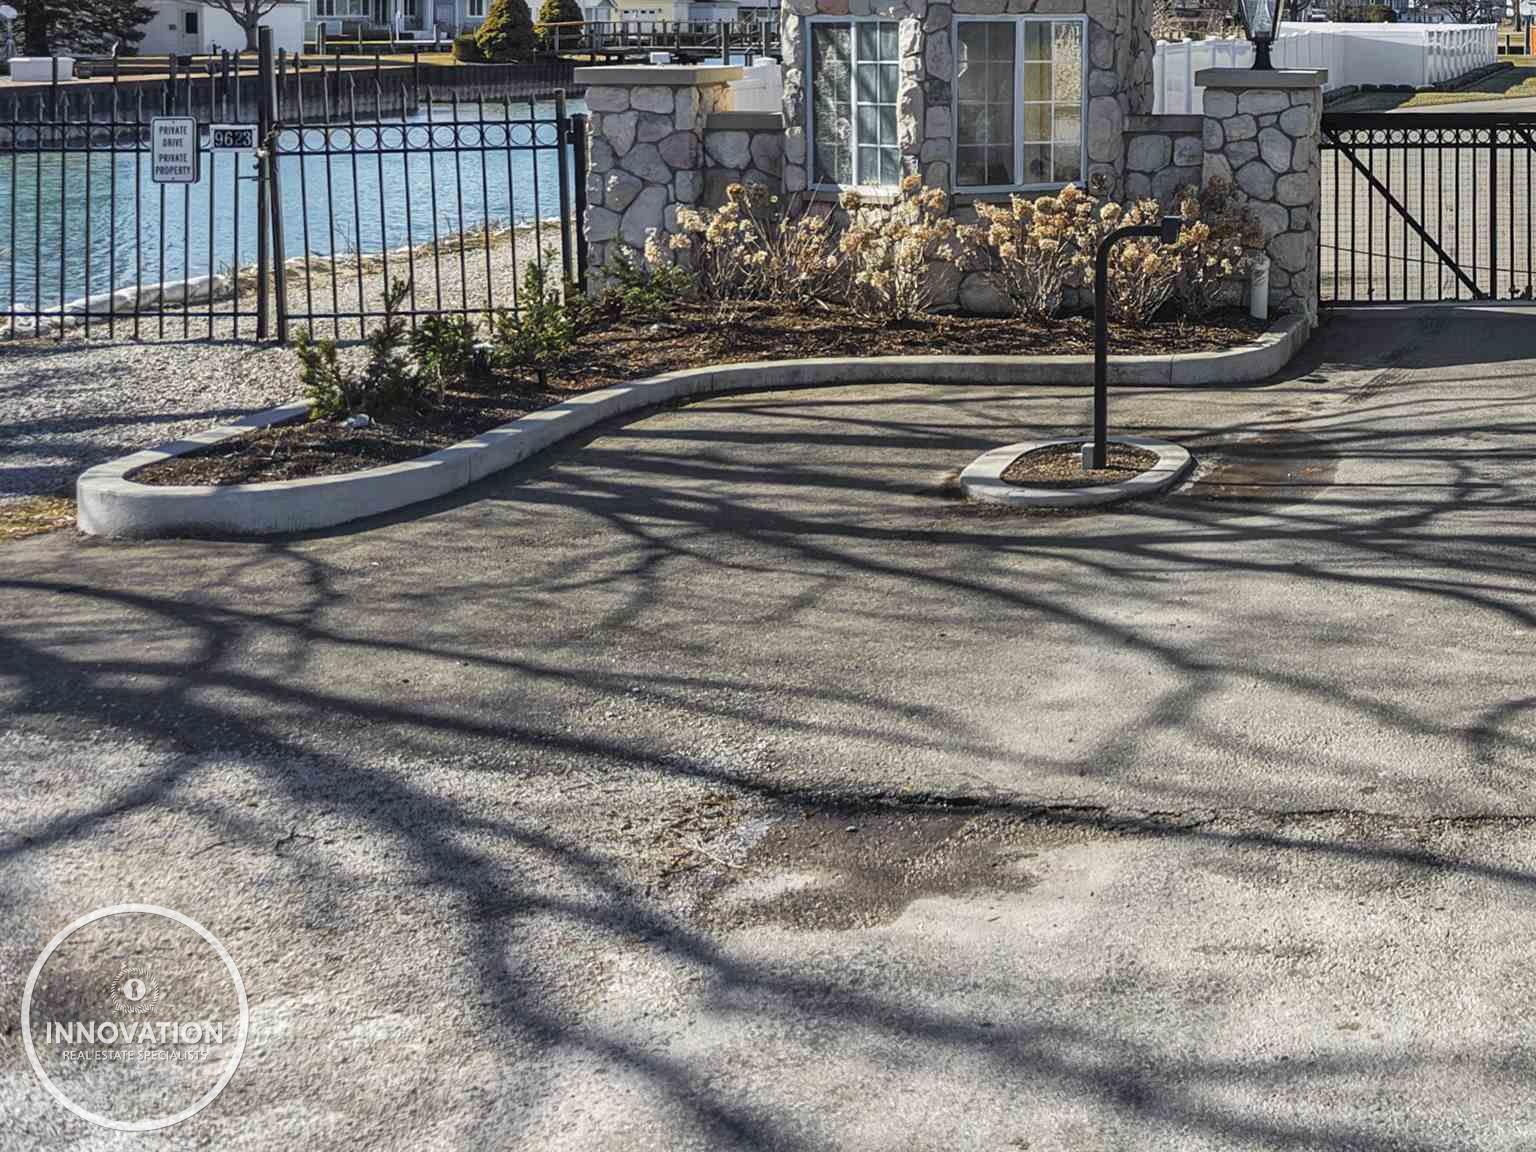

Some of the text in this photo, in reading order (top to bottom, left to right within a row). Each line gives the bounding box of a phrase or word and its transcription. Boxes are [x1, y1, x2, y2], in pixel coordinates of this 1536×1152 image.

[159, 126, 188, 135] PRIVATE
[162, 138, 183, 147] DRIVE
[214, 130, 252, 146] 9623
[159, 153, 188, 162] PRIVATE
[155, 165, 191, 176] PROPERTY
